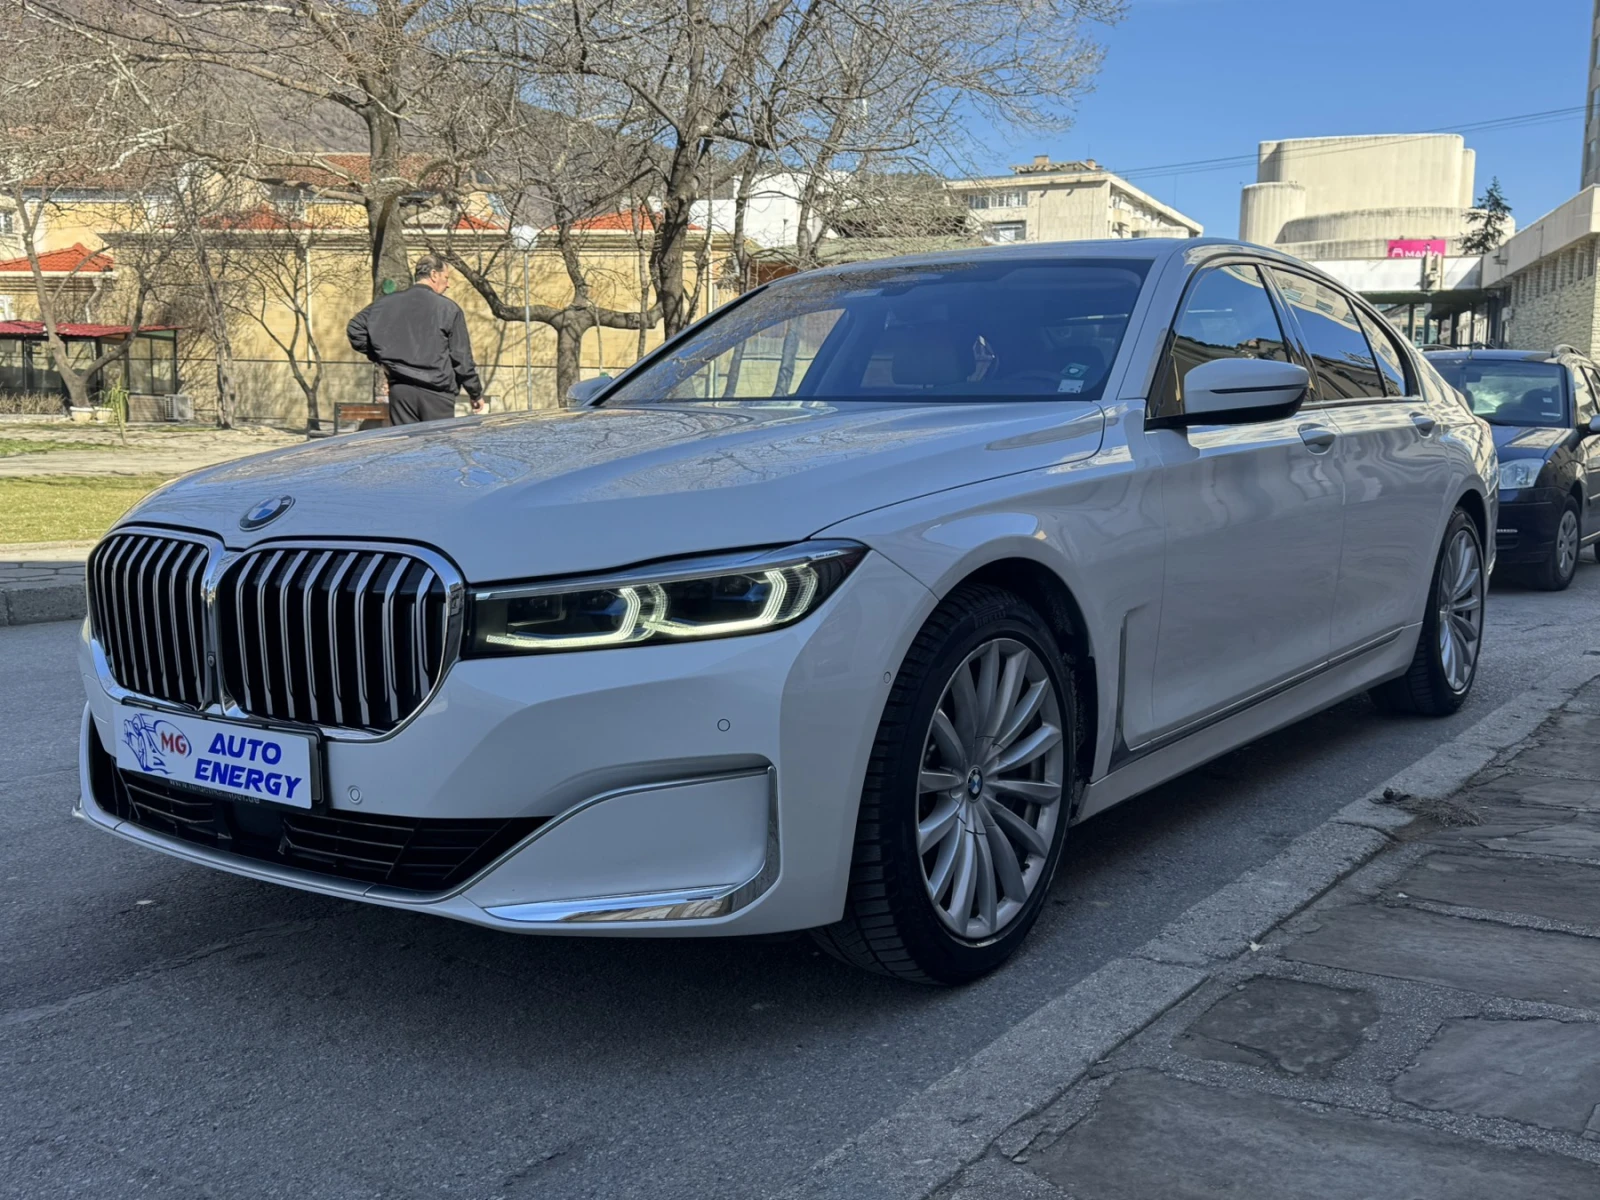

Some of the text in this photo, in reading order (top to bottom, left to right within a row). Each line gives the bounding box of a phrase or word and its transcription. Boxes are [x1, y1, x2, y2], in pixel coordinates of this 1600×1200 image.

[161, 731, 187, 755] MG
[208, 733, 282, 765] AUTO
[194, 758, 302, 799] ENERGY
